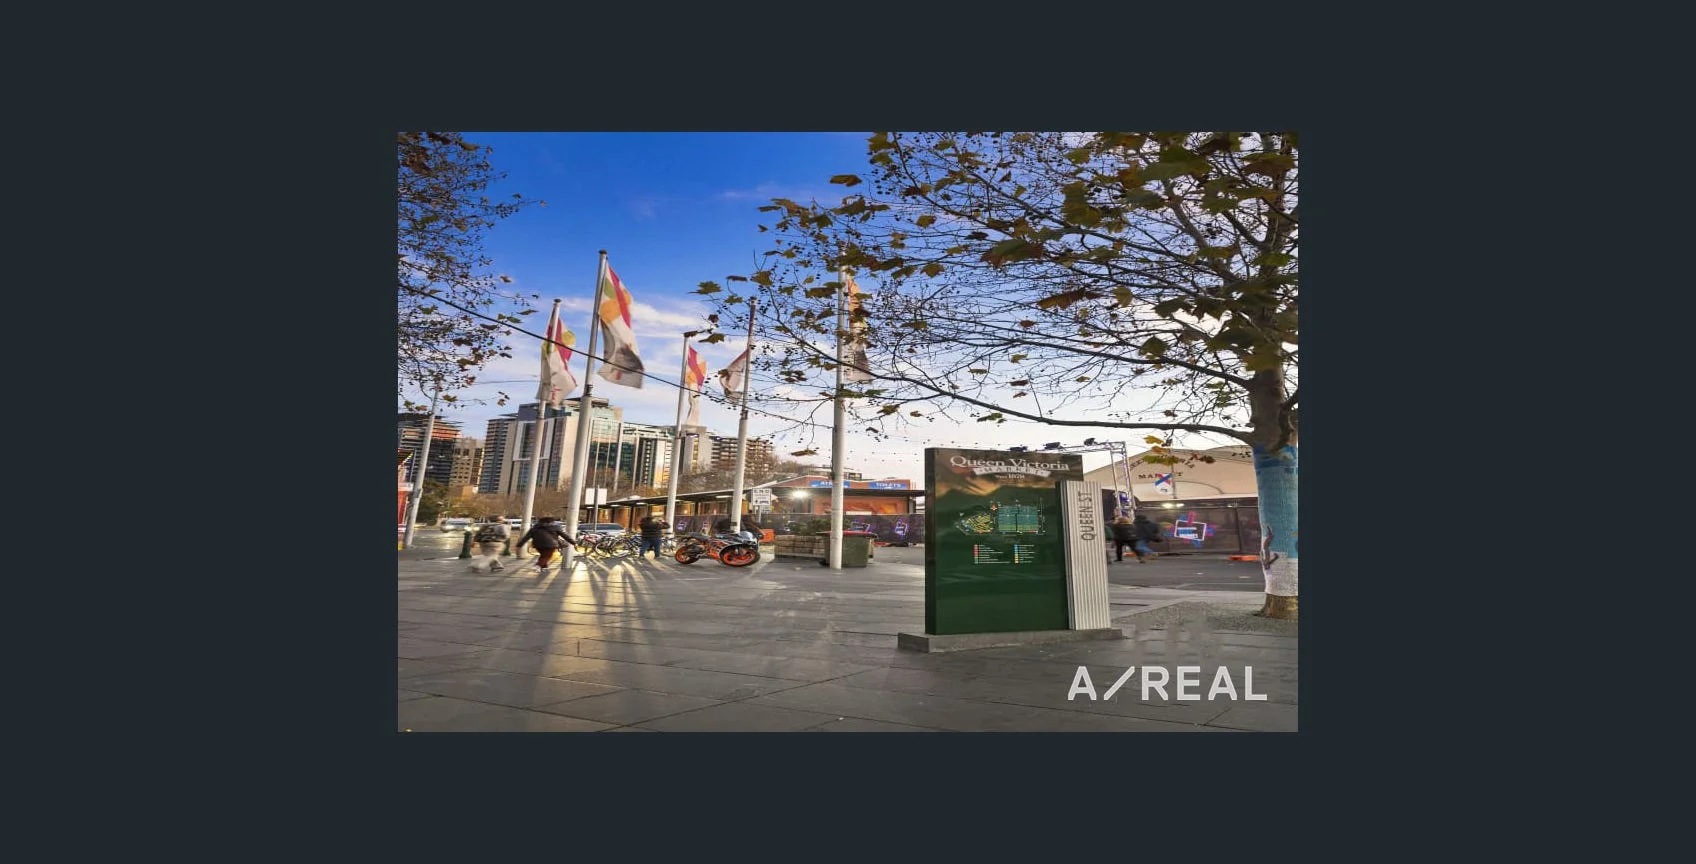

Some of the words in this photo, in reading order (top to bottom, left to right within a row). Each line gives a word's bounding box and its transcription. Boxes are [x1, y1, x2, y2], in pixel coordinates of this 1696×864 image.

[950, 455, 1005, 468] Queen
[1009, 458, 1070, 470] Victoria
[1078, 490, 1092, 502] ST
[1078, 506, 1097, 541] QUEEN
